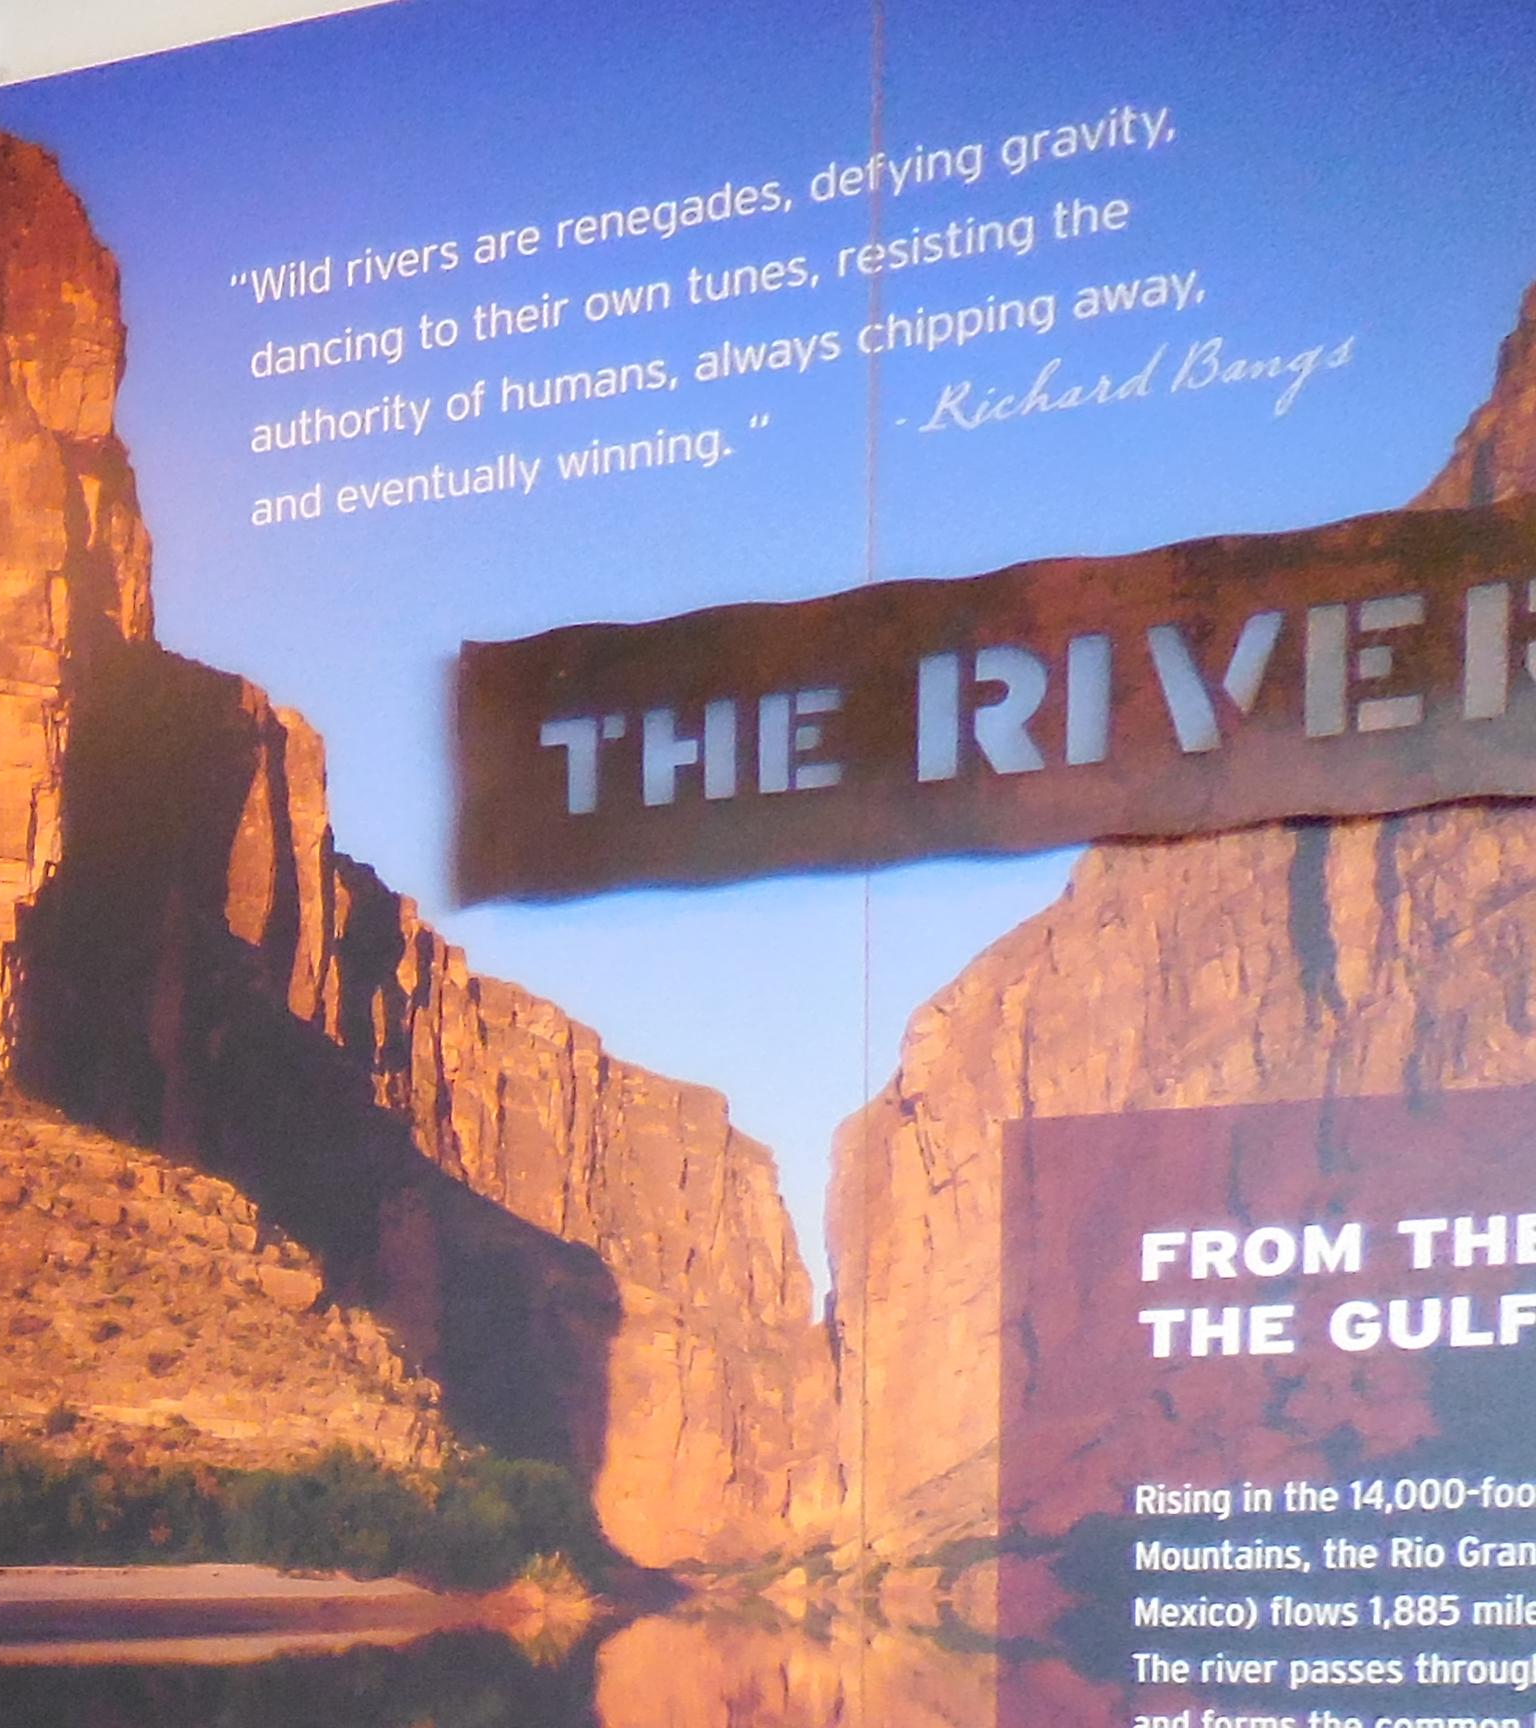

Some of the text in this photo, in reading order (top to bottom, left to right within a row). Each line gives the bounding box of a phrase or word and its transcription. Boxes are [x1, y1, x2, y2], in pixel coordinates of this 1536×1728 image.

[347, 240, 458, 287] rivers
[474, 226, 540, 264] are
[557, 182, 792, 248] renegades,
[810, 144, 982, 202] defying
[1001, 105, 1176, 175] gravity,
[251, 198, 1129, 378] dancing to their own tunes, resisting the
[251, 269, 1205, 453] authority of humans, always chipping away,
[918, 336, 1355, 432] Richard Bangs
[251, 485, 321, 526] and
[336, 452, 541, 513] eventually
[541, 688, 843, 815] THE
[1141, 1223, 1362, 1281] FROM
[1139, 1294, 1536, 1357] THE GULF
[1135, 1483, 1231, 1520] Rising
[1243, 1482, 1271, 1512] in
[1284, 1481, 1338, 1512] the
[1135, 1539, 1310, 1573] Mountains,
[1324, 1539, 1377, 1569] the
[1391, 1536, 1444, 1568] Rio
[1134, 1596, 1257, 1630] Mexico)
[1270, 1596, 1358, 1626] flows
[1369, 1594, 1459, 1630] 1,885
[1131, 1653, 1536, 1691] The river passes throug
